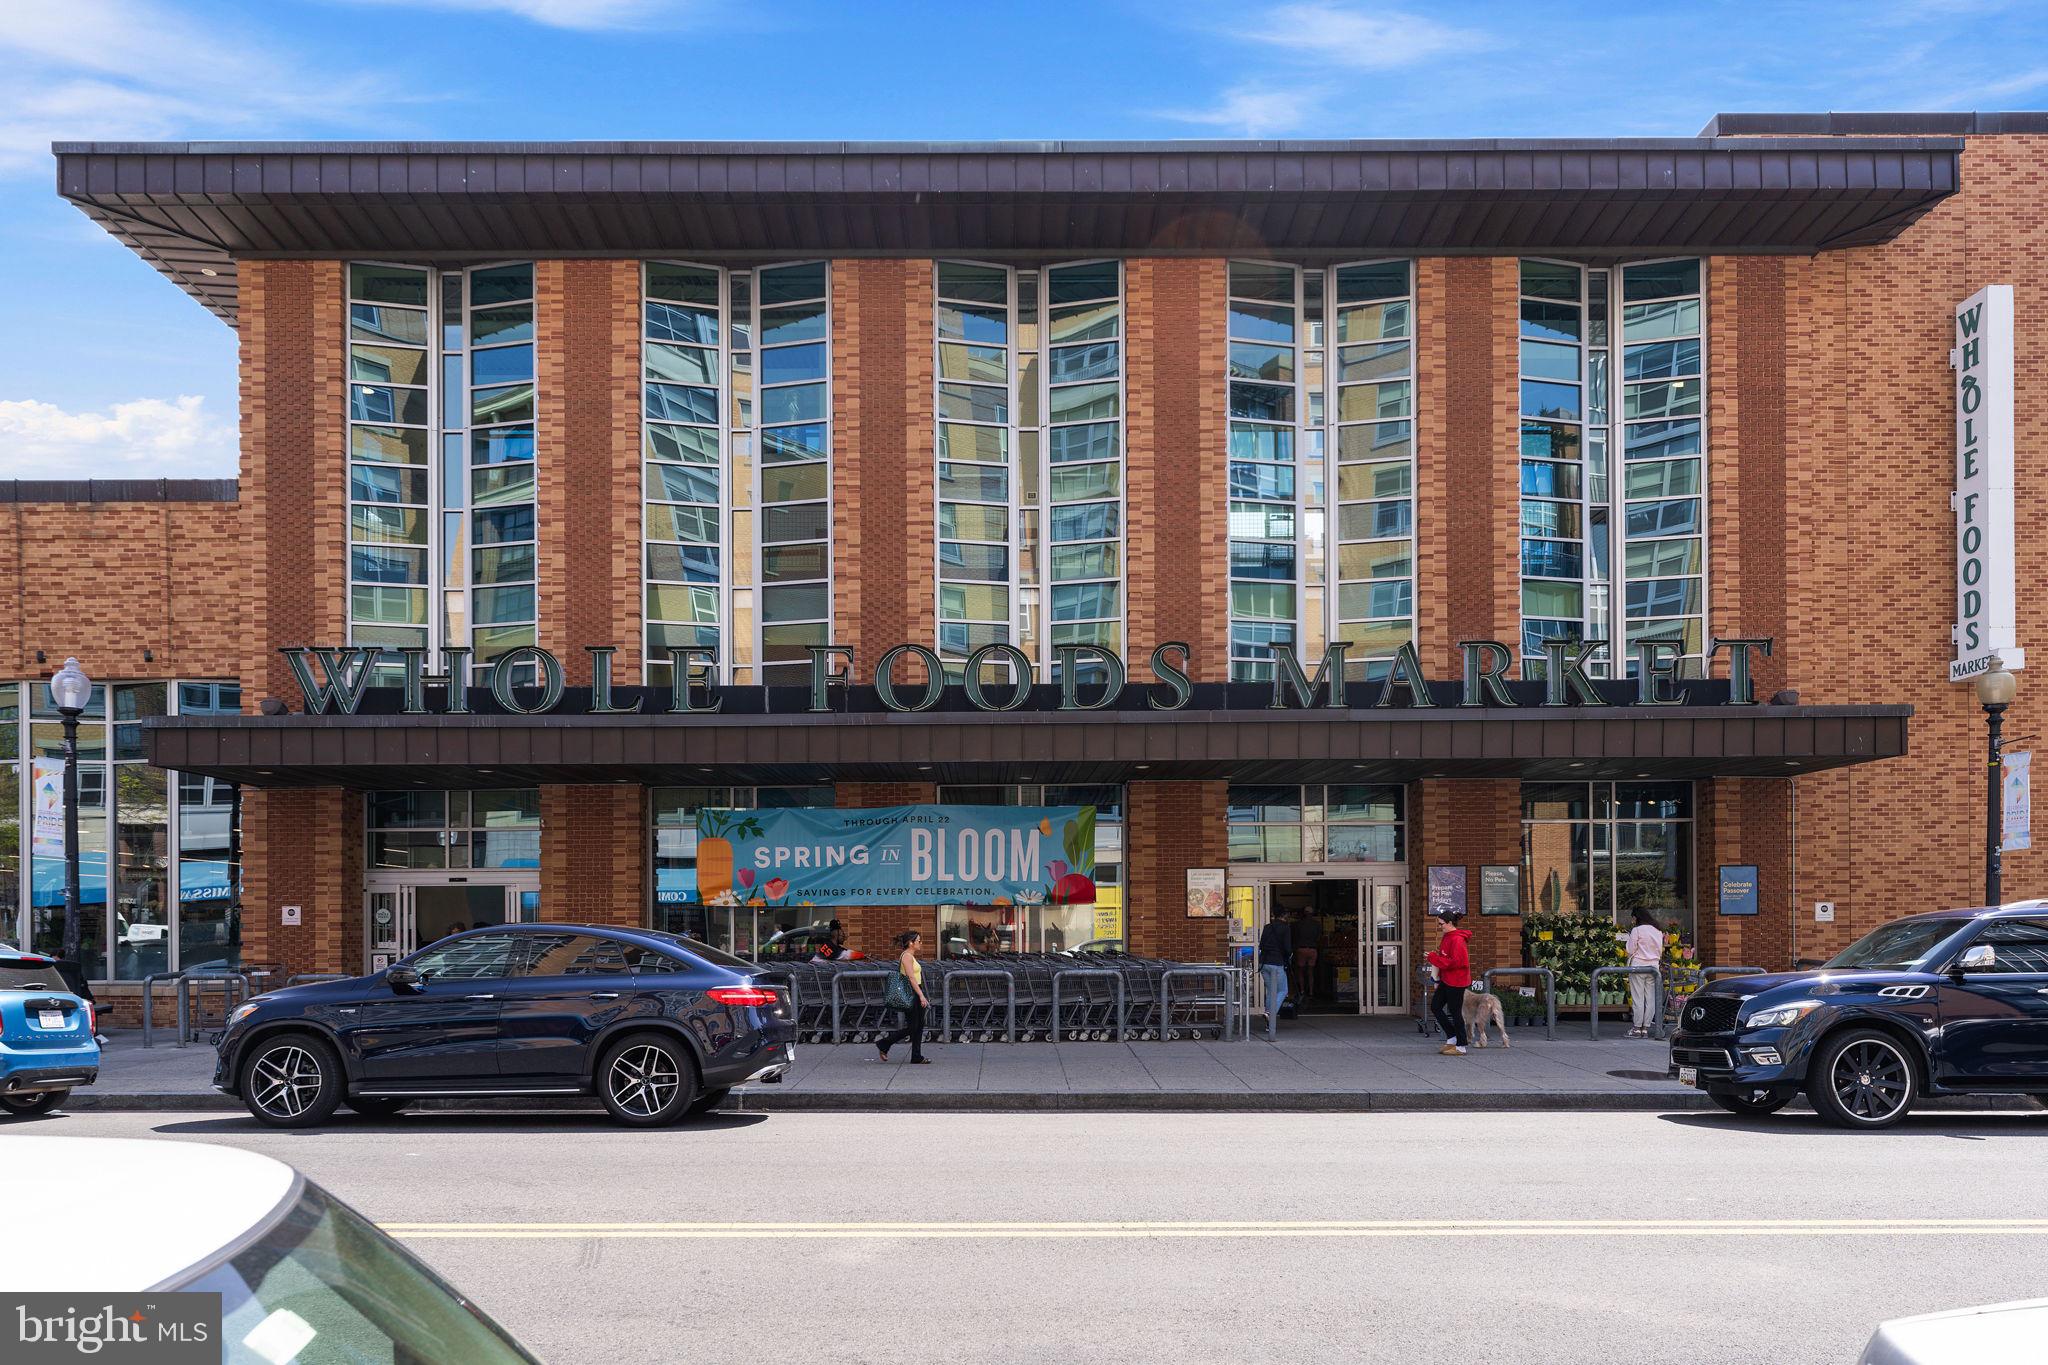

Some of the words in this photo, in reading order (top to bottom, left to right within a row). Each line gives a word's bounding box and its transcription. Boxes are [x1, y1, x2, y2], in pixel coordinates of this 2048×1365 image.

[1958, 302, 1983, 480] WHOLE
[1962, 493, 1982, 651] FOODS
[278, 646, 723, 715] WHOLE
[805, 642, 1194, 712] FOODS
[1265, 637, 1774, 709] MARKET
[844, 817, 898, 827] THROUGH
[903, 815, 933, 823] APRIL
[754, 845, 869, 869] SPRING
[881, 849, 900, 861] IN
[911, 828, 1040, 882] BLOOM
[797, 888, 846, 897] SAVINGS
[851, 888, 872, 896] FOR
[877, 887, 910, 896] EVERY
[915, 887, 995, 896] CELEBRATION.
